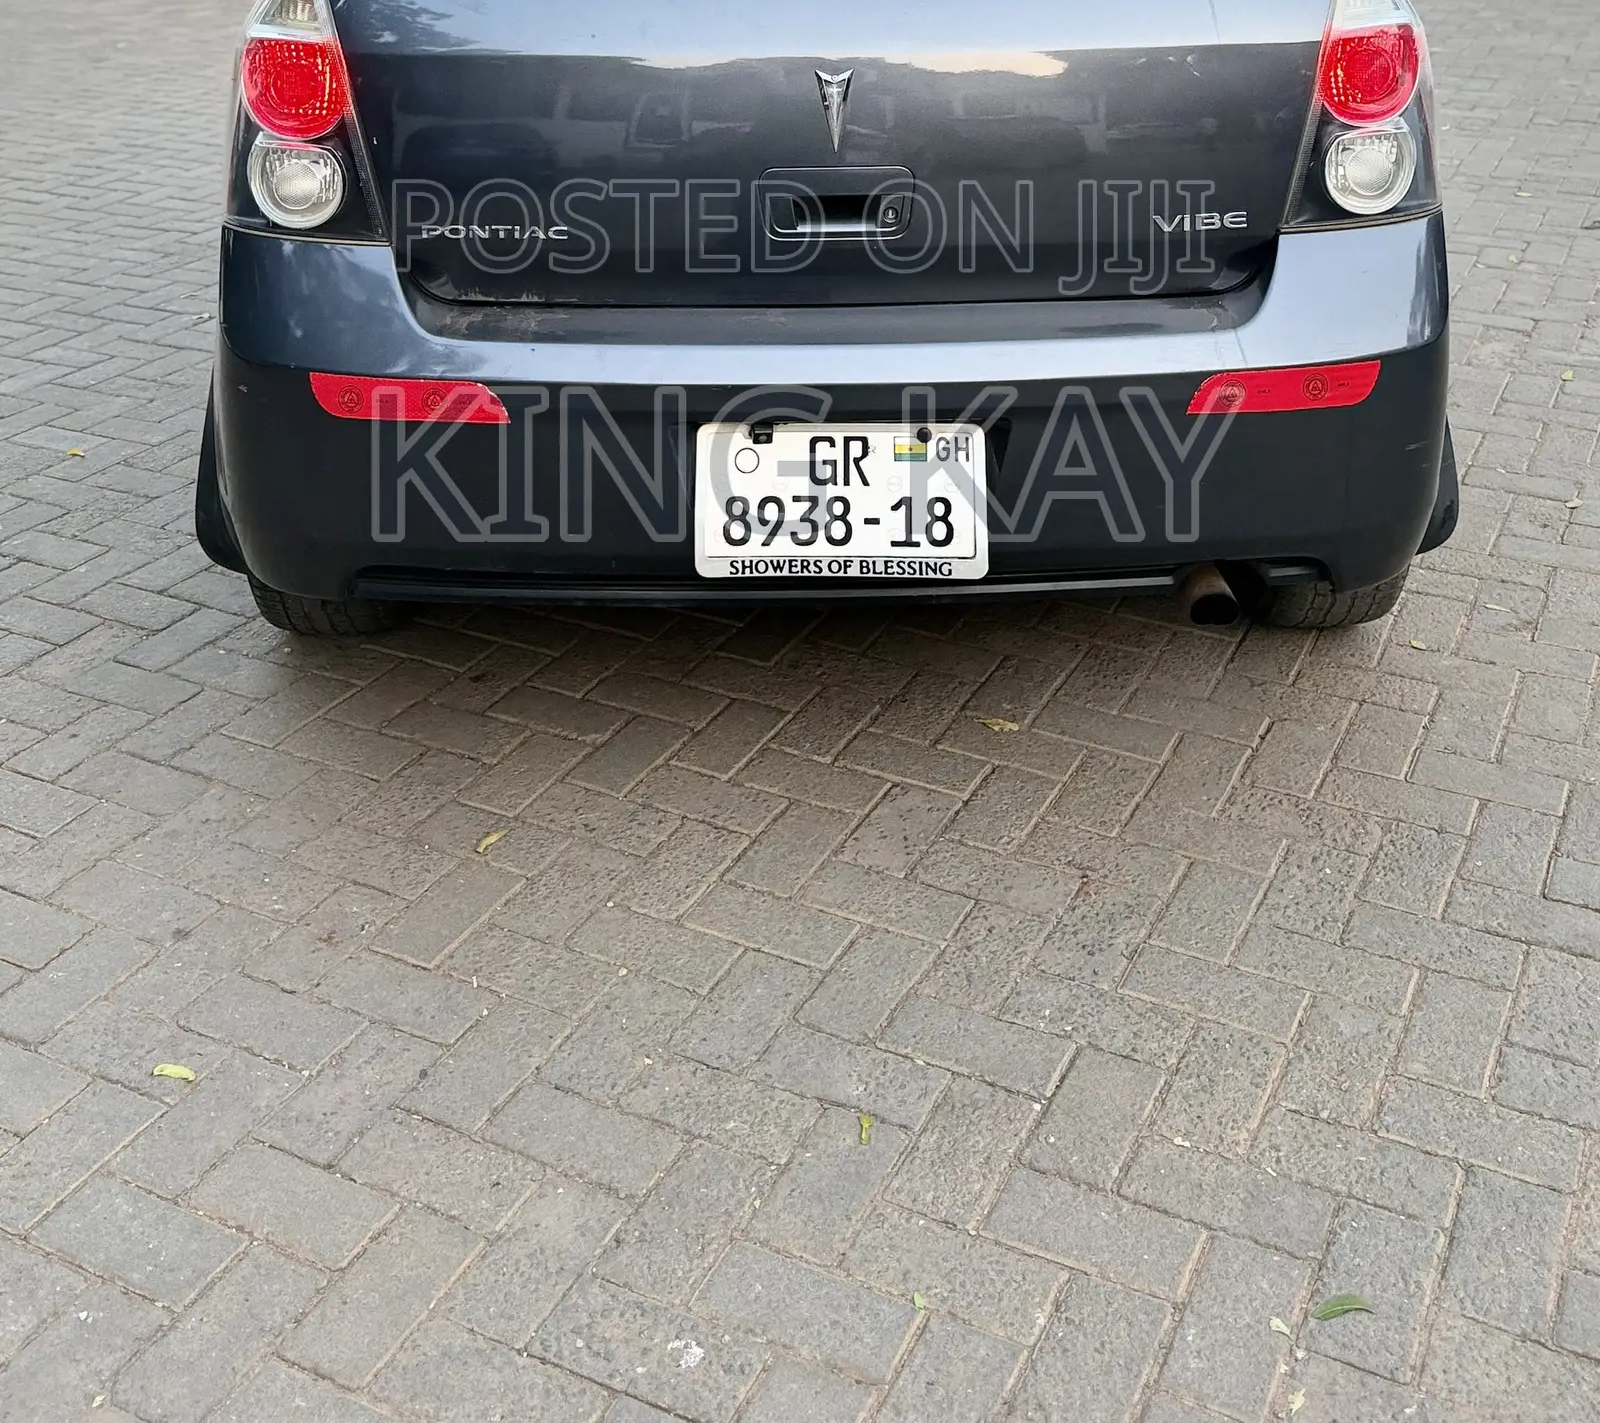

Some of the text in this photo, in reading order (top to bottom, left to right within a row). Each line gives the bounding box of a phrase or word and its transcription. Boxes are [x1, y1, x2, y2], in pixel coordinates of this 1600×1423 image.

[421, 224, 569, 240] PONTIAC
[1151, 211, 1248, 233] VIBE
[809, 435, 870, 487] GR
[935, 436, 970, 463] GH
[722, 495, 954, 548] 8938-18
[729, 559, 953, 577] SHOWERS OF BLESSING
